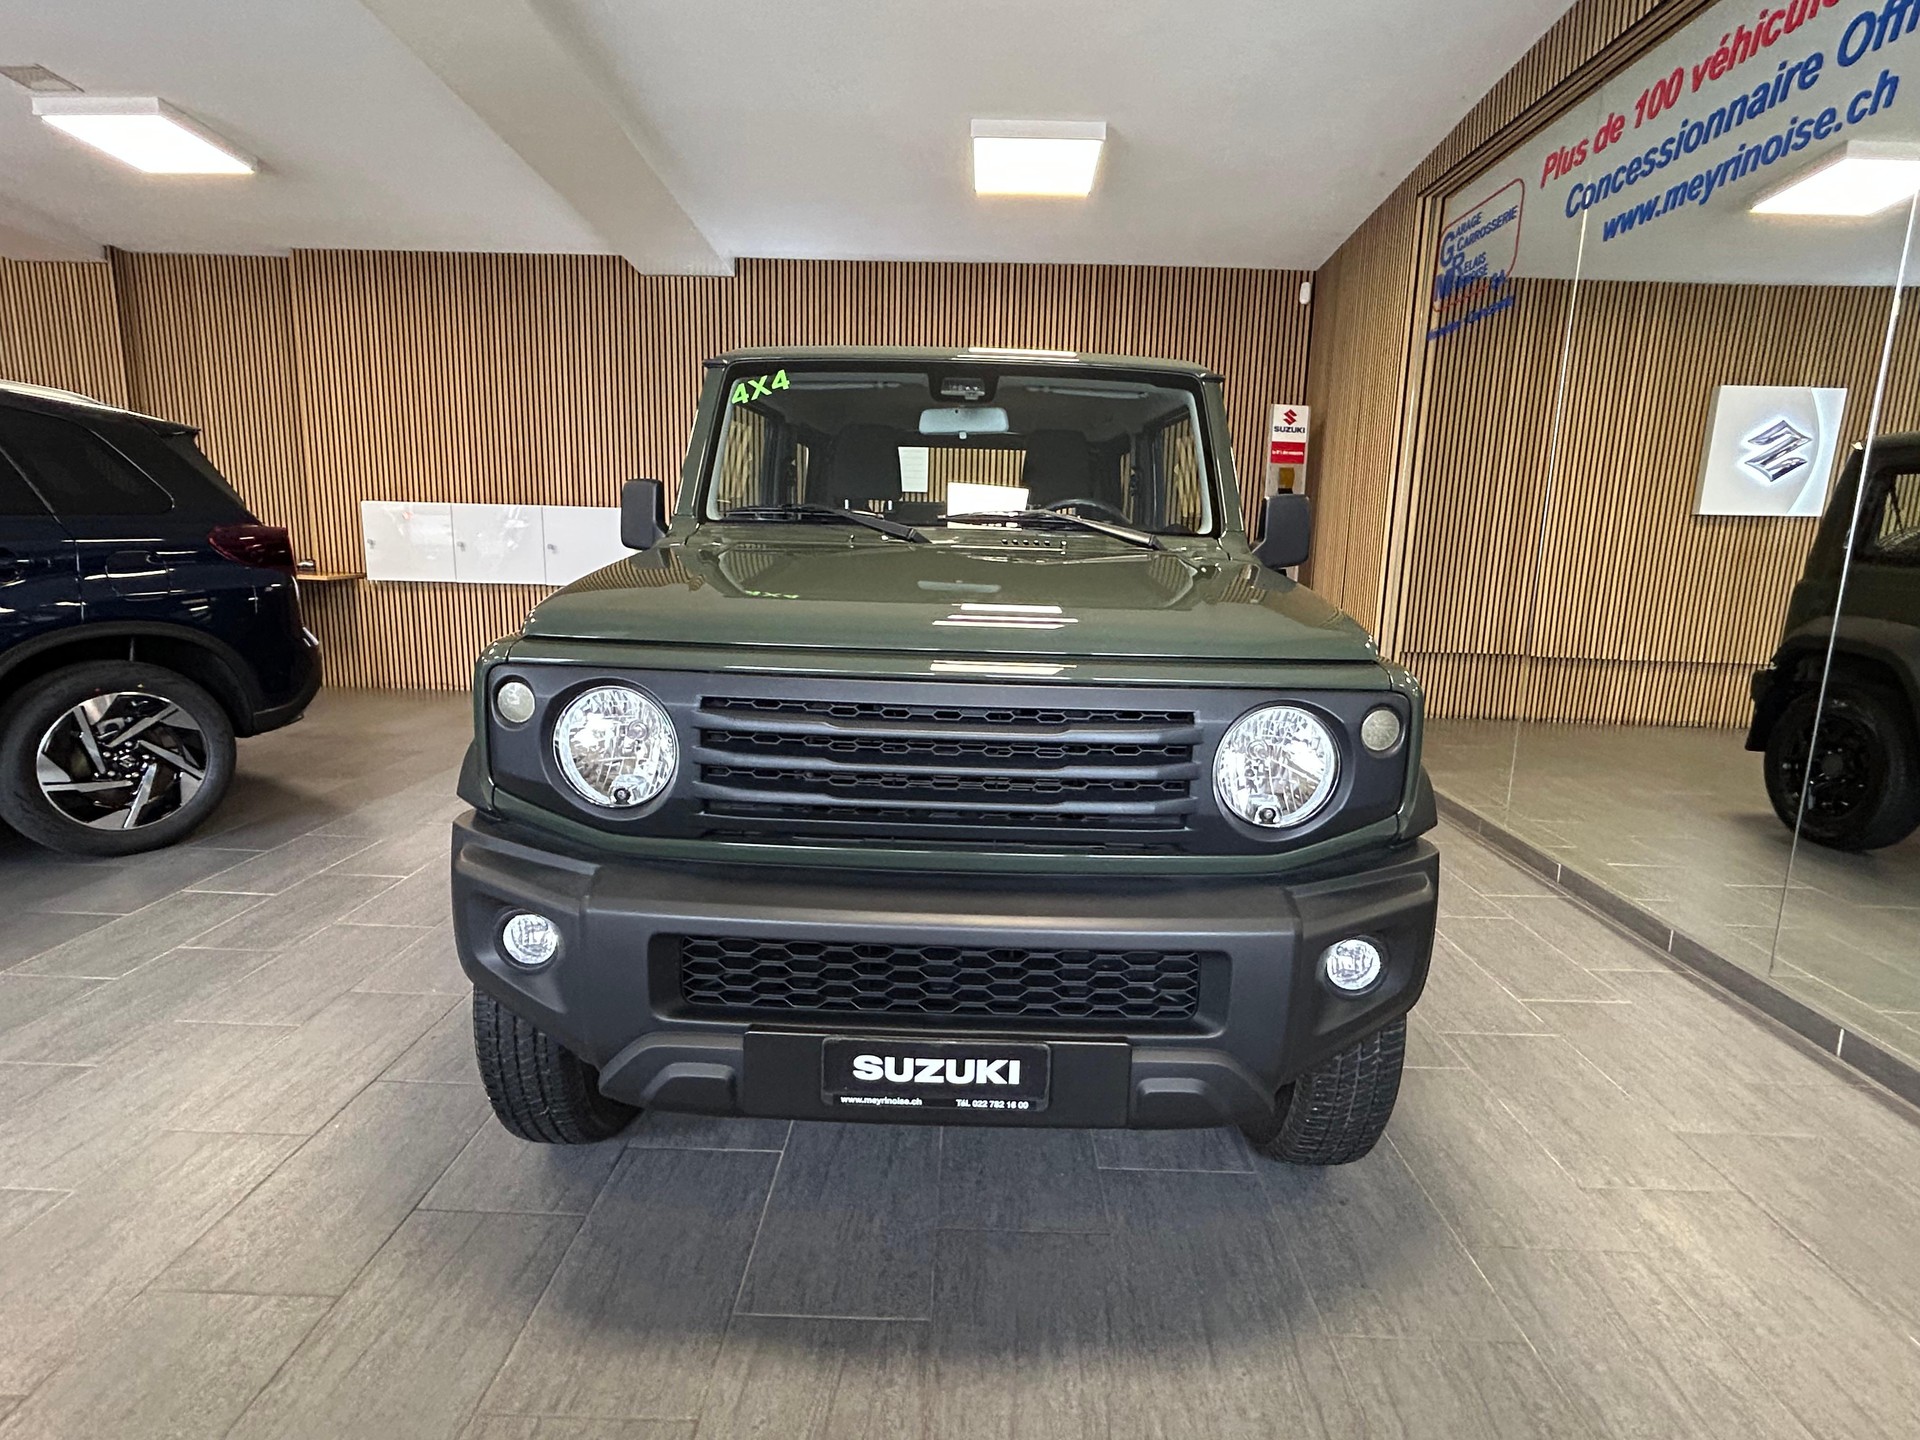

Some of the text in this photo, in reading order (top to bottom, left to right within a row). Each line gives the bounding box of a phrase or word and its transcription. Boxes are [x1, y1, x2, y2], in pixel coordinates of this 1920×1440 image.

[1540, 0, 1840, 189] Plus de 100 véhicu
[1565, 52, 1824, 218] Concessionnaire
[1602, 69, 1899, 242] www.meyrinoise.ch
[1457, 205, 1518, 251] CARROSSERIE
[731, 369, 790, 404] 4X4
[852, 1054, 1021, 1085] SUZUKI
[840, 1096, 923, 1106] www.meyrinoise.ch
[972, 1100, 987, 1108] 022
[1017, 1101, 1029, 1110] 00
